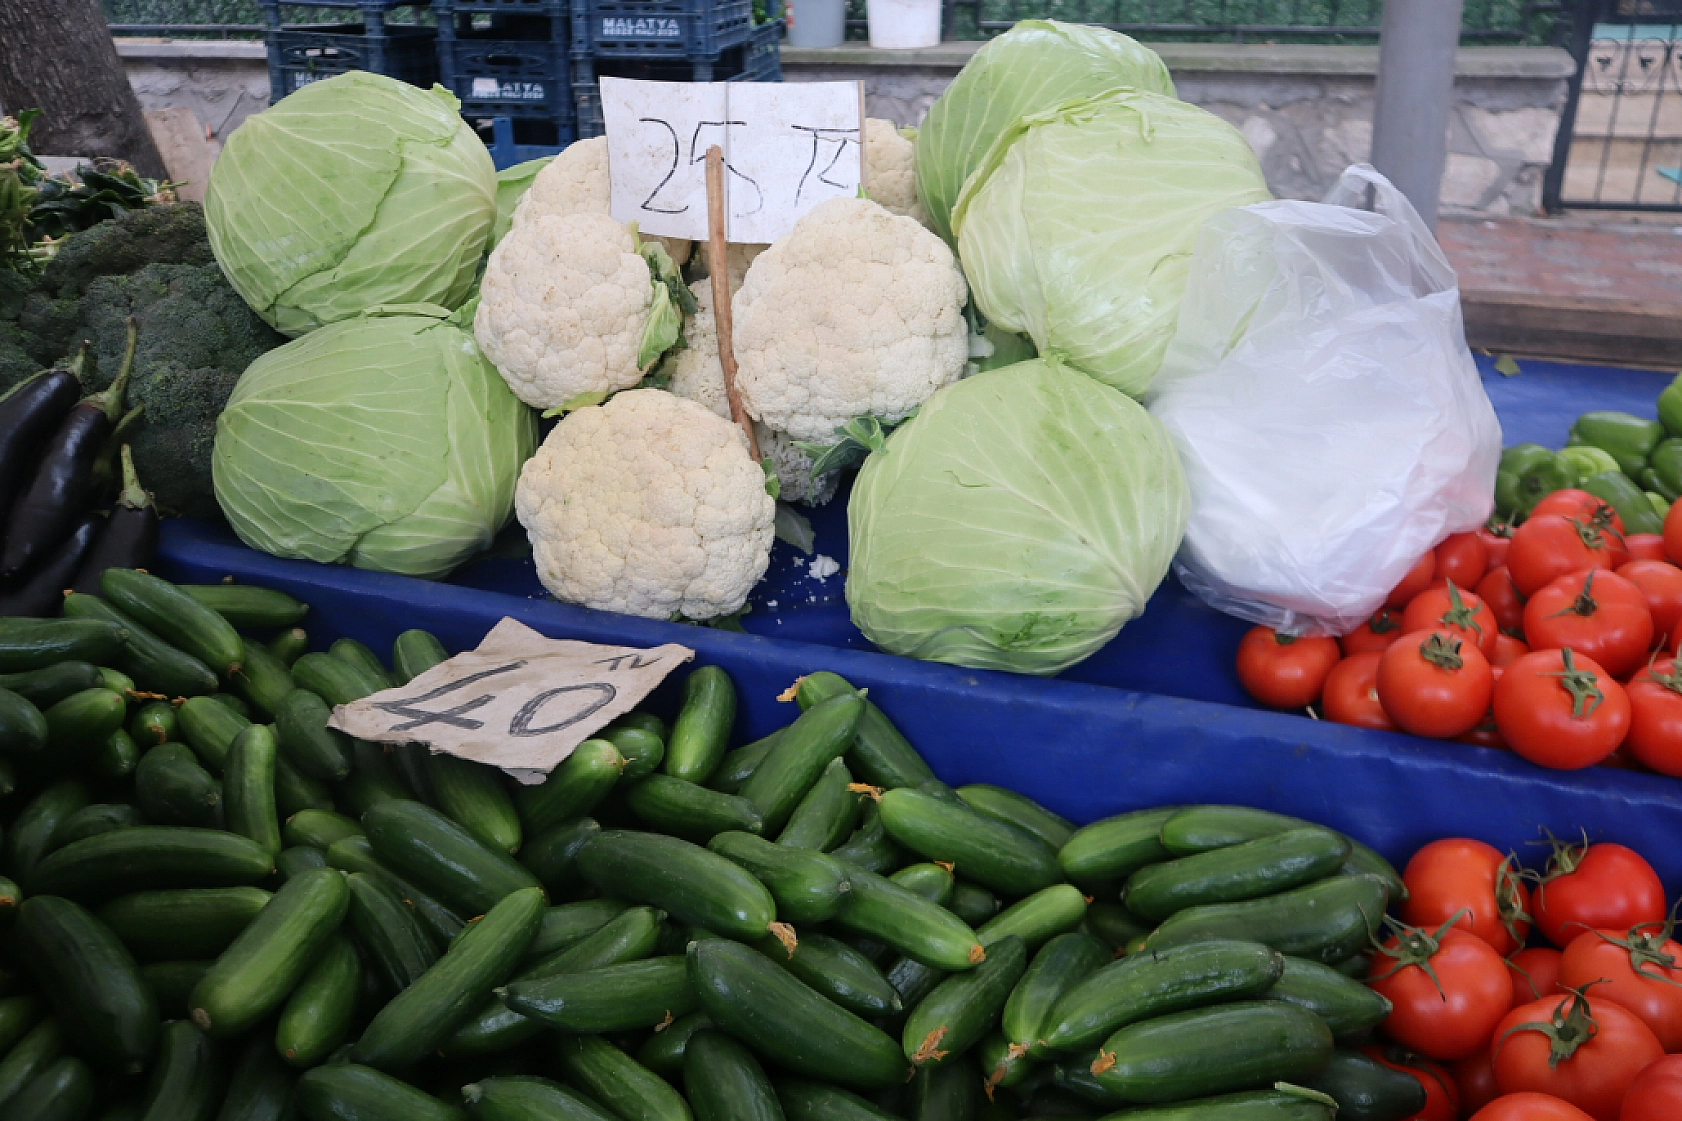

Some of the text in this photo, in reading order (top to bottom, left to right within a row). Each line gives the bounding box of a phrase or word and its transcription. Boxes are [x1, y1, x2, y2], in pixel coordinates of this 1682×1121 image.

[603, 17, 679, 29] MALATYA
[639, 118, 763, 218] 25
[372, 660, 616, 737] 40
